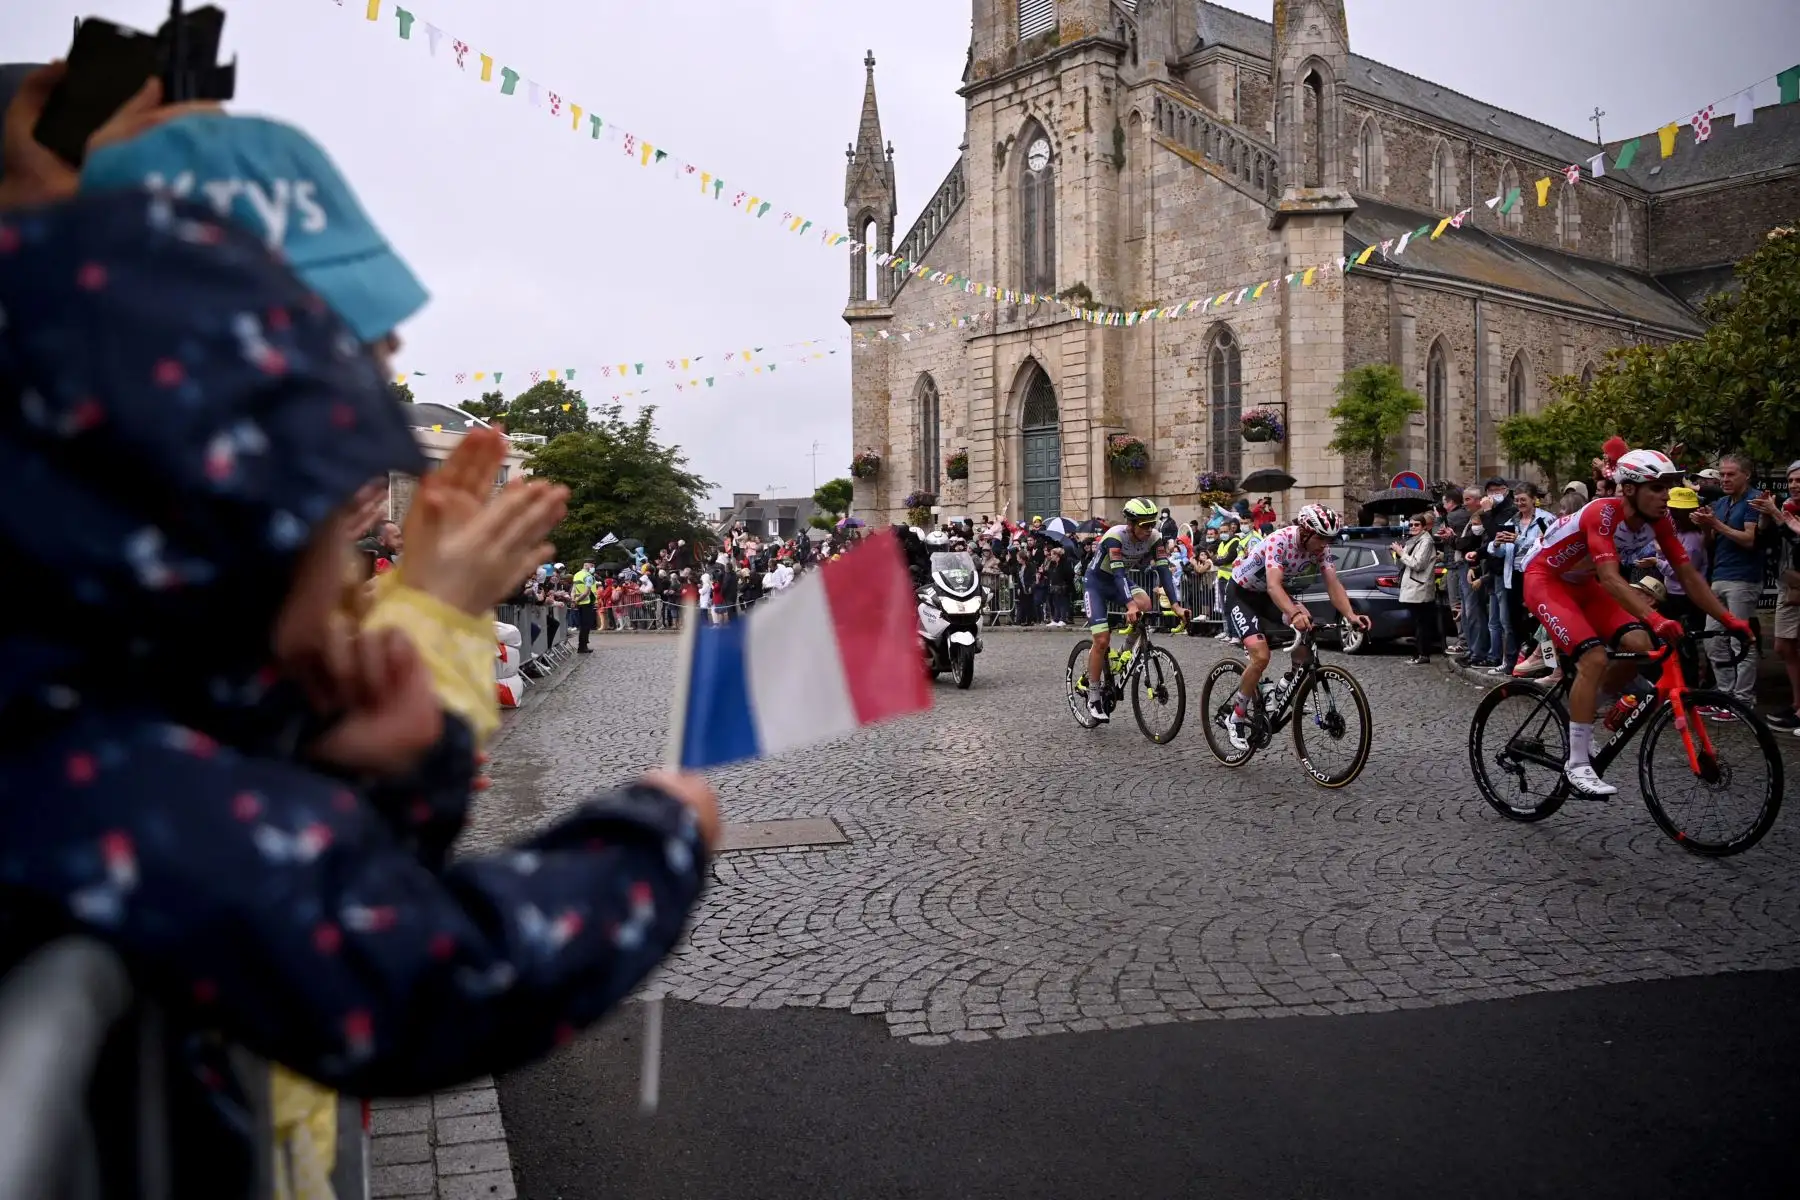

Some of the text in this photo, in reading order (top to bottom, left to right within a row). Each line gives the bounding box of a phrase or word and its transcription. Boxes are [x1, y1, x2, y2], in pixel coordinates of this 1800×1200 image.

[1546, 541, 1585, 568] Cofidis
[1231, 605, 1250, 636] BORA
[1537, 603, 1571, 646] Cofidis
[1324, 671, 1354, 692] roval
[1609, 693, 1655, 746] DE ROSA
